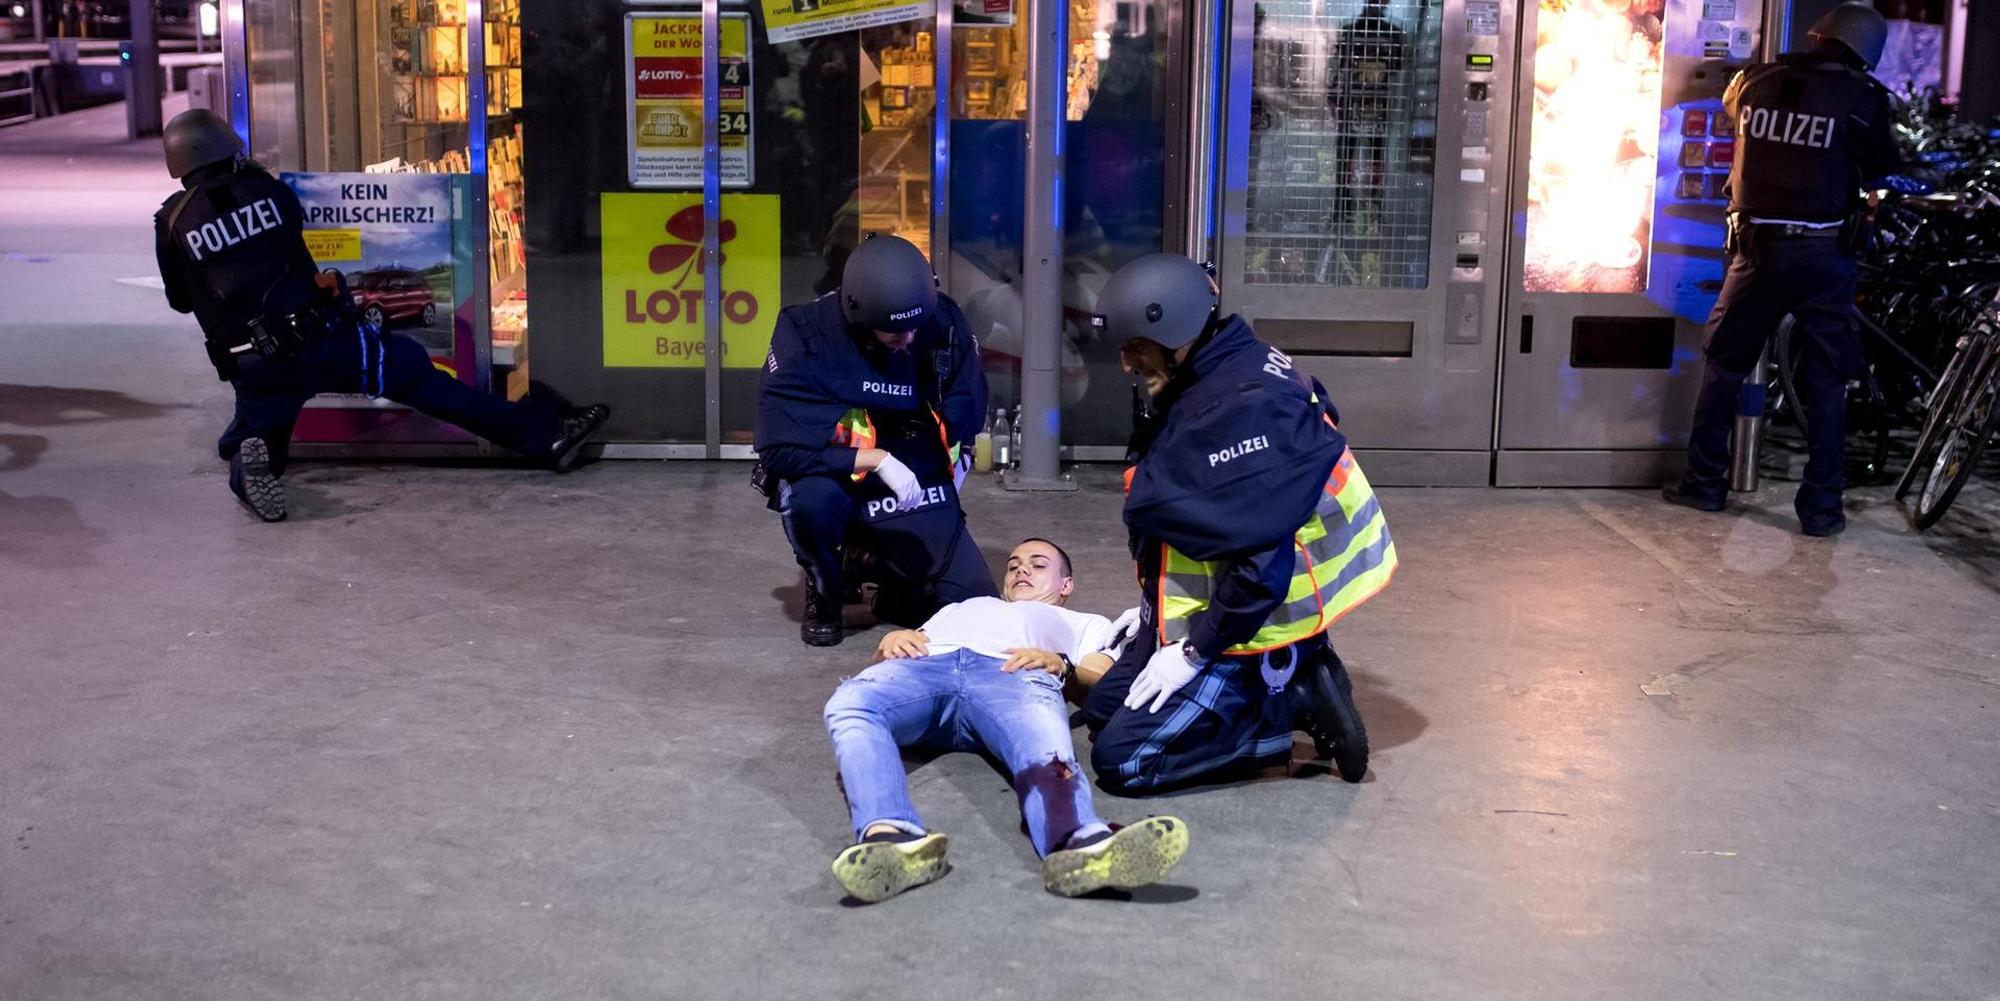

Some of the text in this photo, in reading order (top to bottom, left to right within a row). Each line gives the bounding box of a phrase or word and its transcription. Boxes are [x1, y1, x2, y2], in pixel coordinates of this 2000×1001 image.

[772, 6, 792, 15] rund
[651, 70, 684, 79] LOTTO
[725, 65, 739, 84] 4
[719, 114, 747, 133] 34
[1740, 104, 1836, 149] POLIZEI
[341, 183, 388, 201] KEIN
[301, 206, 434, 224] APRILSCHERZ!
[185, 197, 282, 261] POLIZEI
[625, 289, 758, 324] LOTO
[890, 306, 923, 321] POLIZEI
[656, 336, 728, 360] Bayen
[862, 380, 912, 396] POLIZEI
[1208, 434, 1270, 468] POLIZEI
